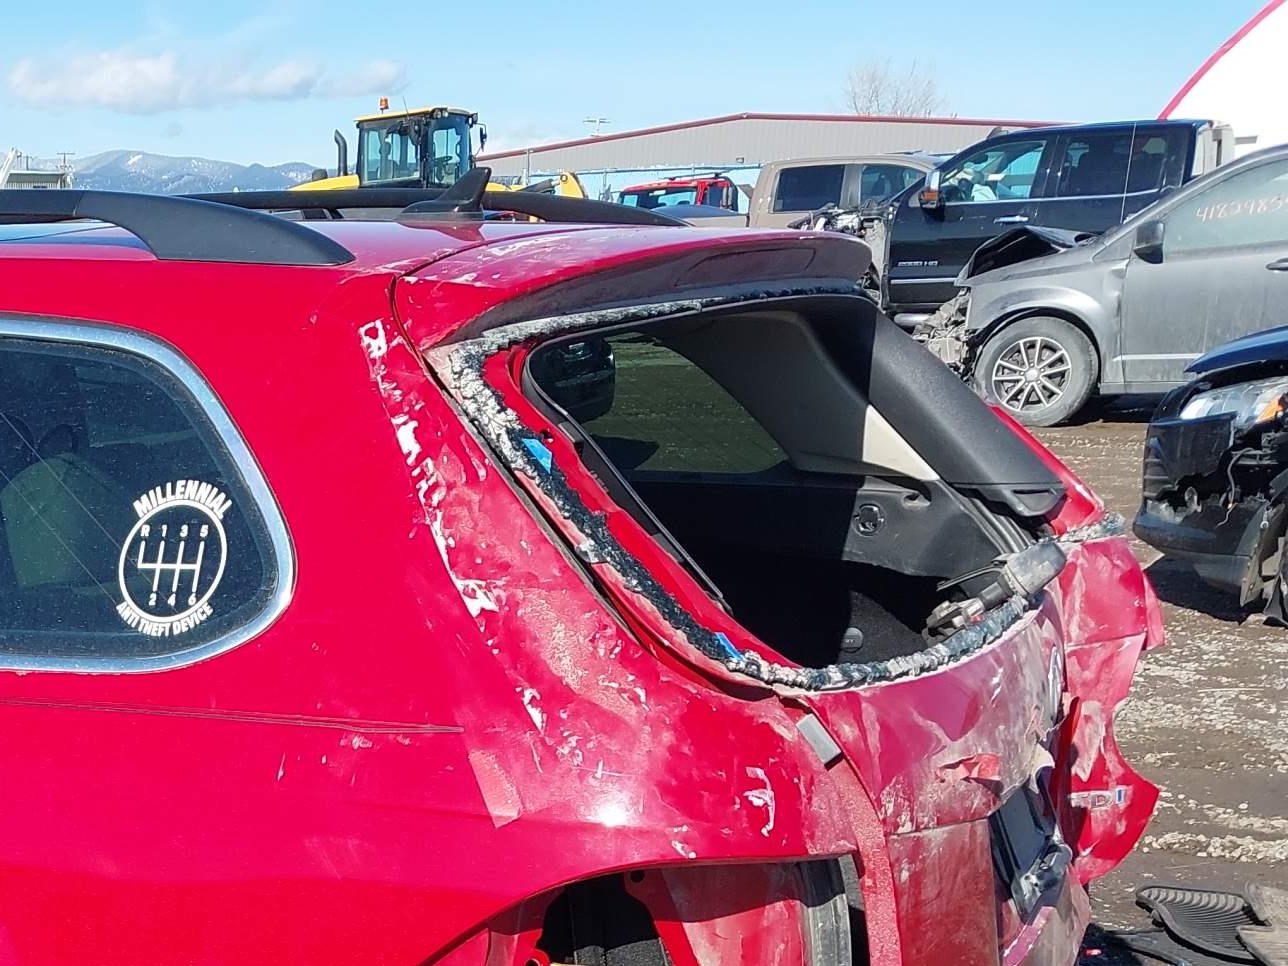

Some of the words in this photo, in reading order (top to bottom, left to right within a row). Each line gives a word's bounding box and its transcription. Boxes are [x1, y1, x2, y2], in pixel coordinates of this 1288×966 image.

[132, 479, 232, 519] MILLENNIAL
[140, 524, 151, 537] R
[161, 524, 168, 538] 1
[179, 524, 189, 538] 3
[199, 524, 209, 538] 5
[148, 592, 157, 606] 2
[167, 593, 177, 607] 4
[187, 593, 197, 606] 6
[115, 601, 139, 628] ANTI
[138, 621, 171, 637] THEFT
[172, 602, 214, 636] DEVICE
